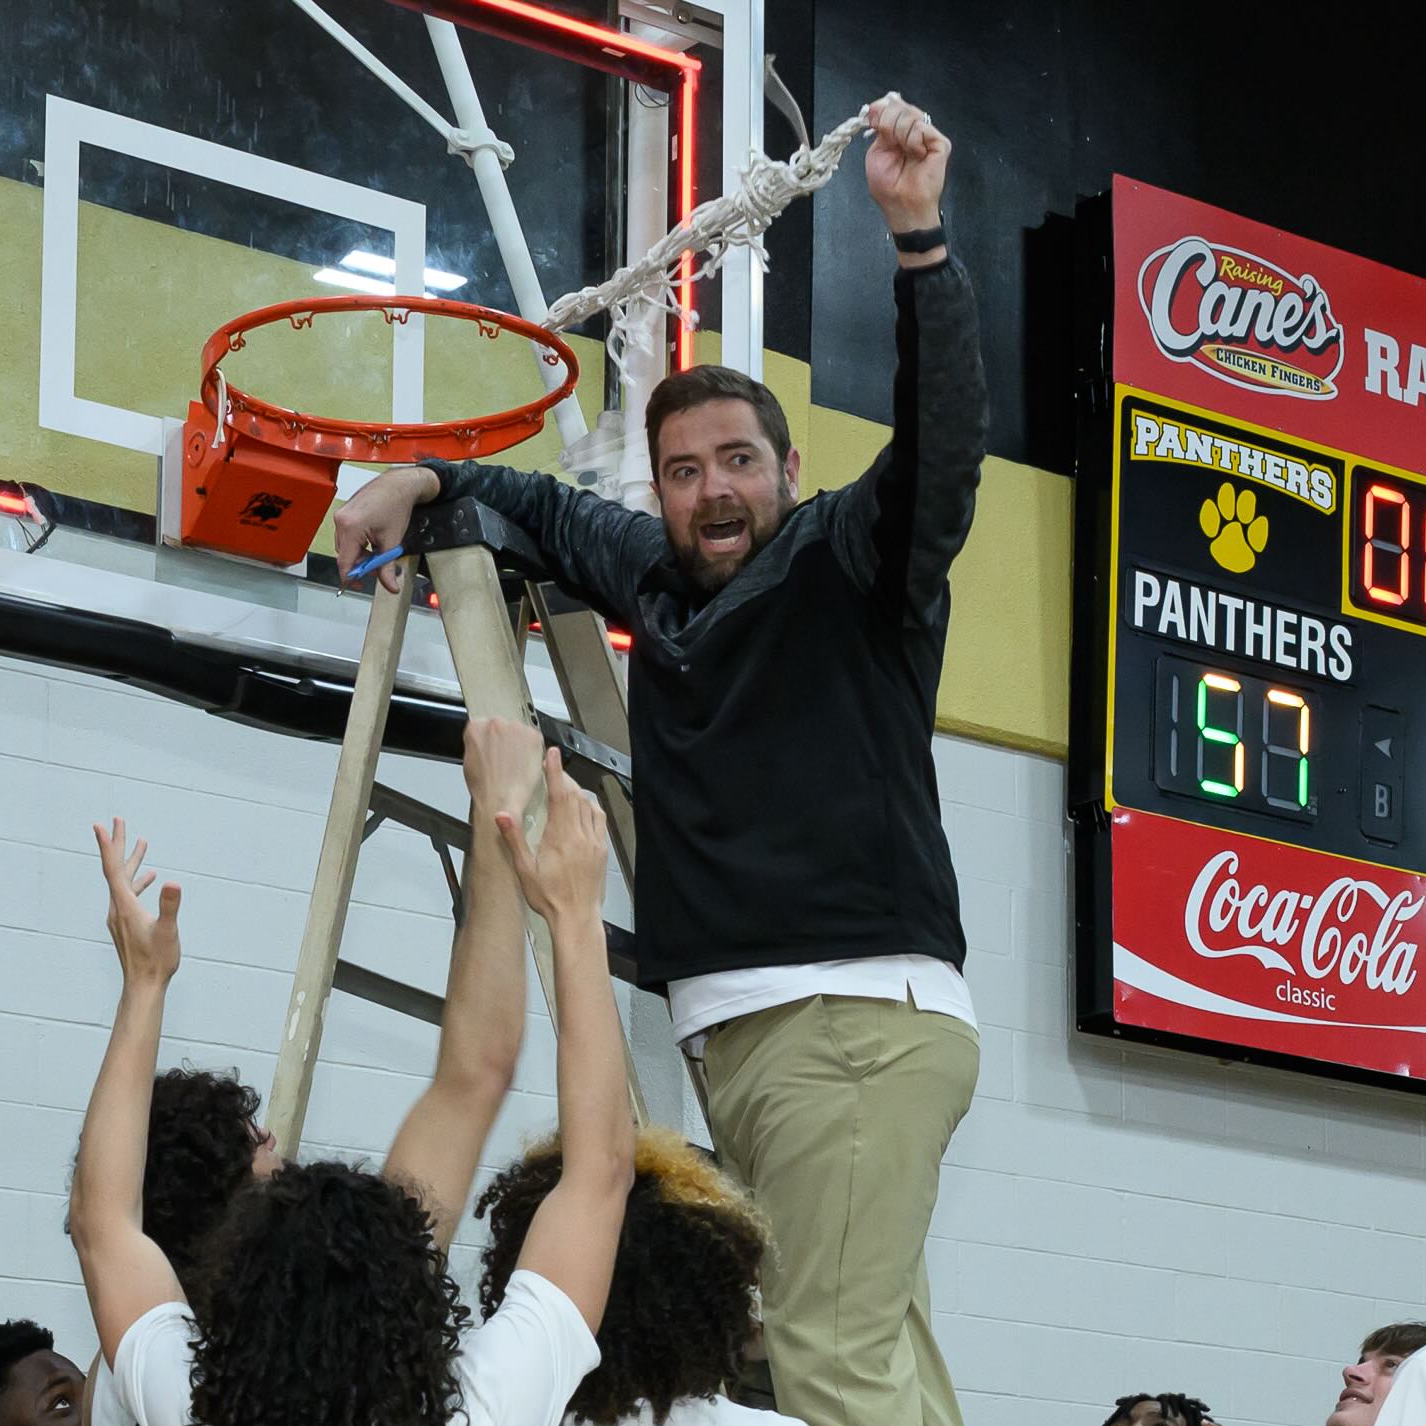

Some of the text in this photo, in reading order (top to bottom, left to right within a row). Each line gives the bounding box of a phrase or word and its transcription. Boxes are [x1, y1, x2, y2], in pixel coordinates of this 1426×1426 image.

[1151, 239, 1339, 350] Cane's
[1219, 256, 1284, 296] Raising
[1216, 349, 1321, 392] CHICKEN FINGERS
[1134, 415, 1334, 511] PANTHERS
[1133, 570, 1353, 682] PANTHERS
[1196, 673, 1310, 807] 57
[1184, 850, 1426, 996] Coca-Cola
[1275, 979, 1337, 1011] classic
